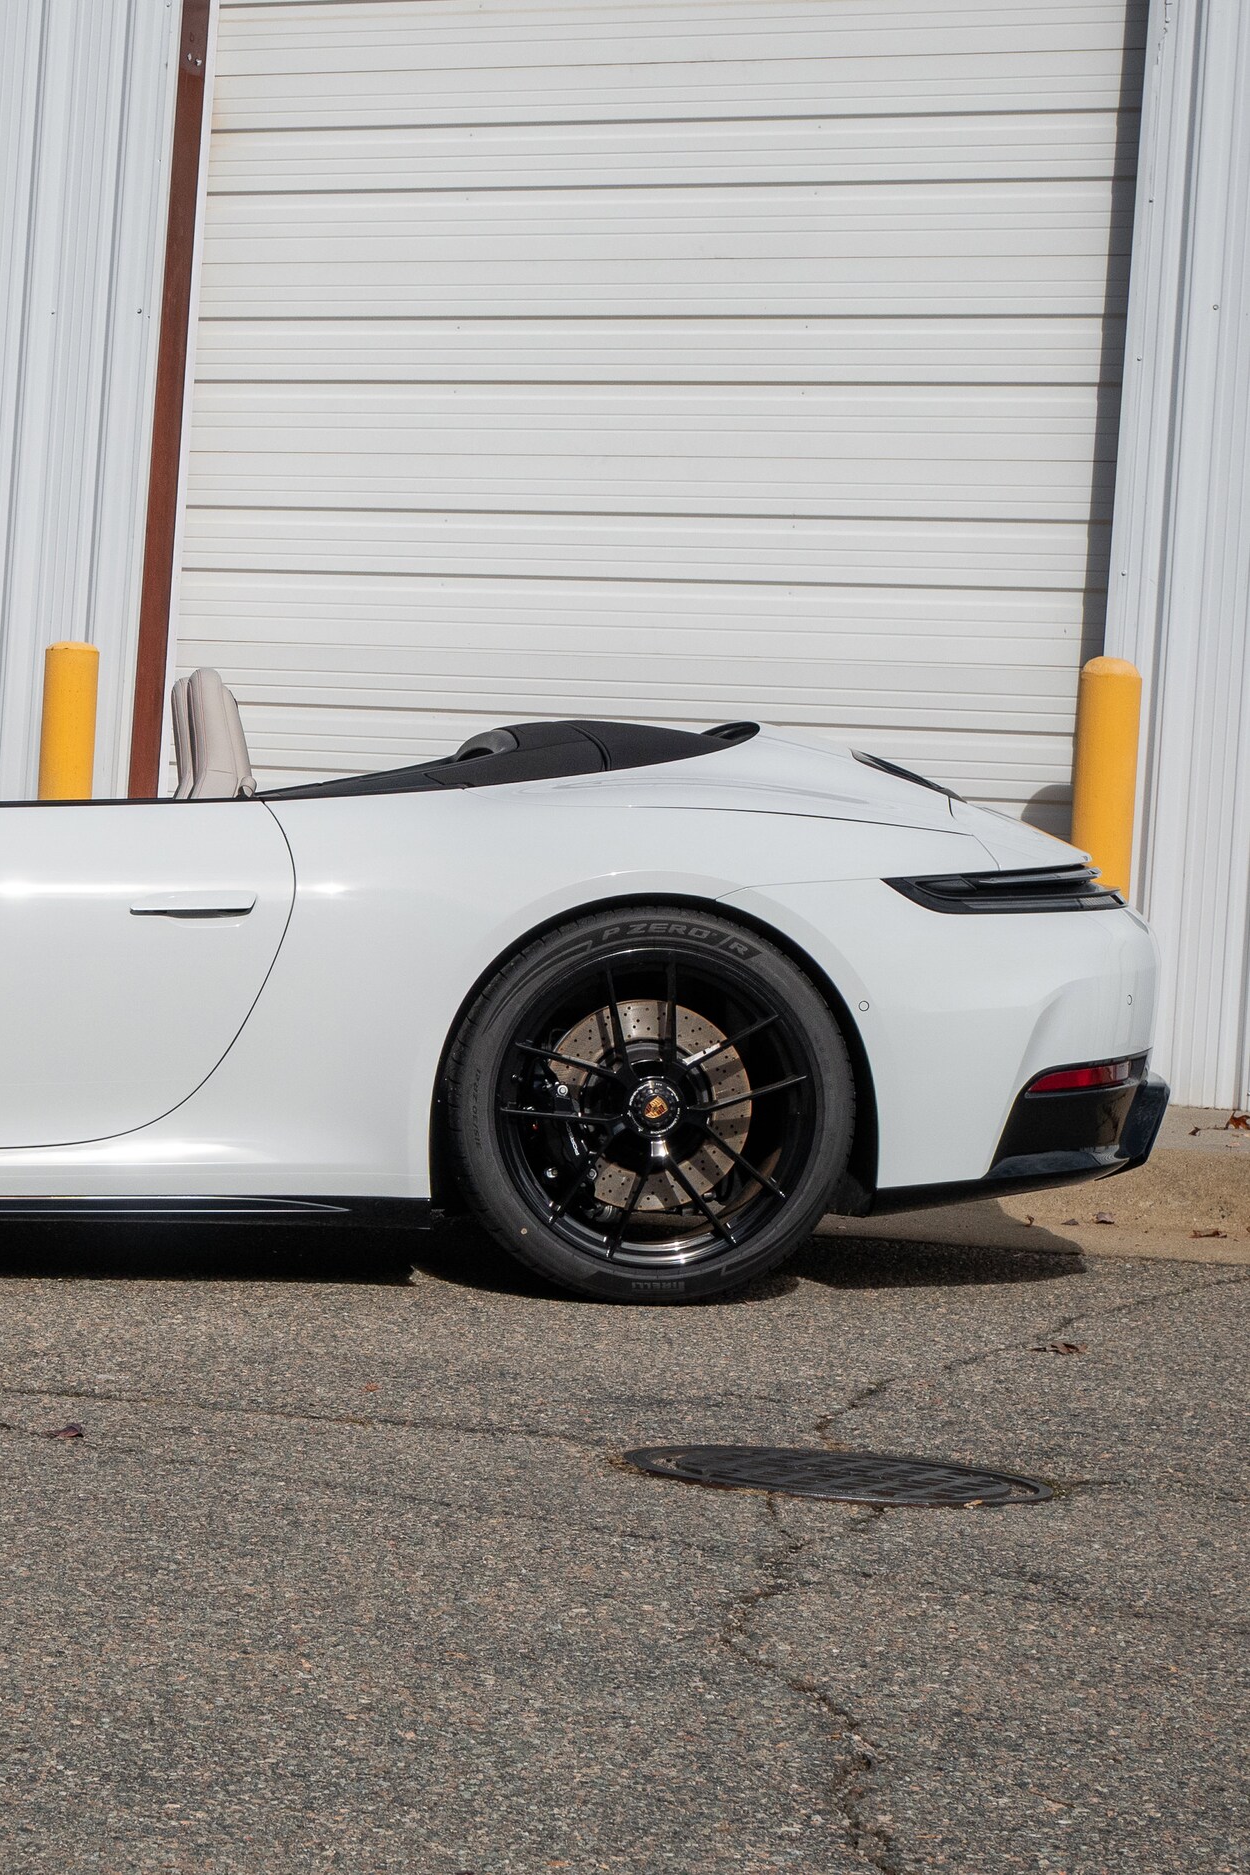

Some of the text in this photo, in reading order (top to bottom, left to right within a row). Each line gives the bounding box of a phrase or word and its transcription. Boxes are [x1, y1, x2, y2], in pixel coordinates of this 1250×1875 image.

[602, 922, 749, 956] P ZERO R
[630, 1280, 686, 1294] PIRELLI
